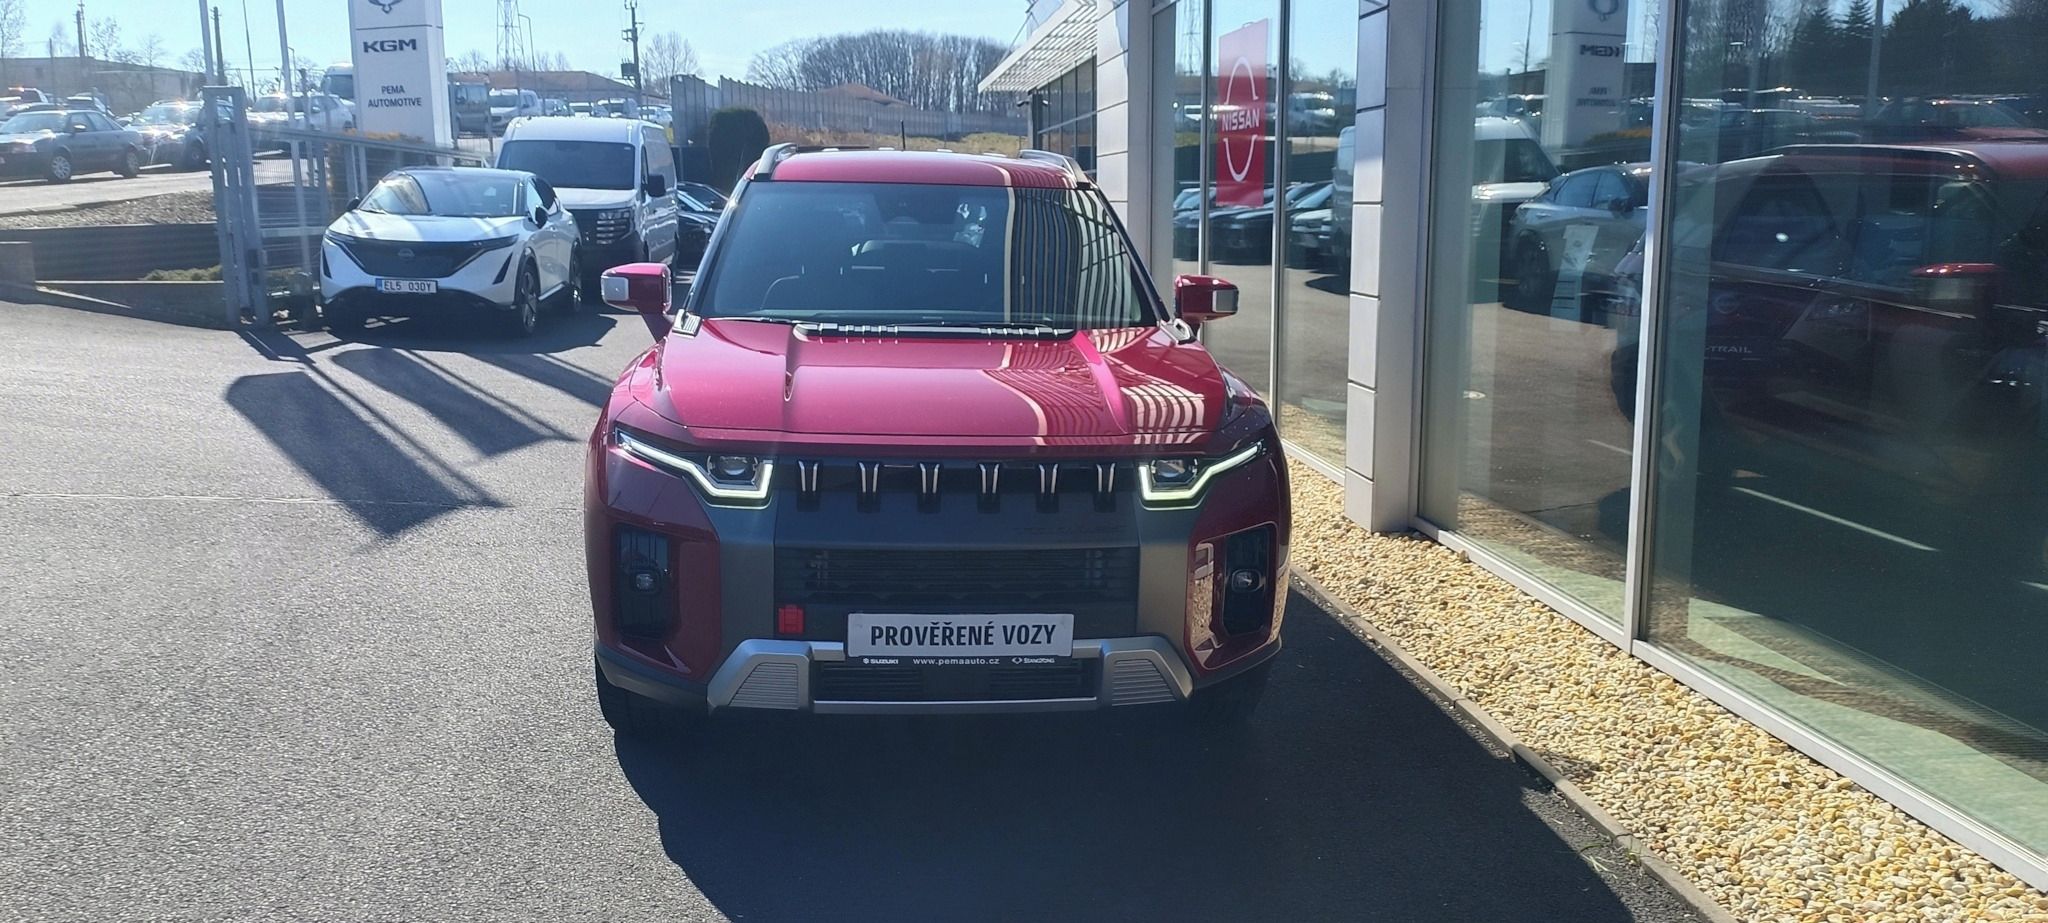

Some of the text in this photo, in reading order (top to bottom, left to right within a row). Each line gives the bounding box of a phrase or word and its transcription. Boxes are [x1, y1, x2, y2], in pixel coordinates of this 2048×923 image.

[363, 39, 416, 53] KGM
[381, 85, 405, 94] PEMA
[368, 97, 422, 107] AUTOMOTIVE
[1221, 109, 1260, 131] NISSAN
[870, 621, 1057, 646] PROVĚŘENÉ VOZY
[912, 658, 1000, 666] www.pemaauto.cz
